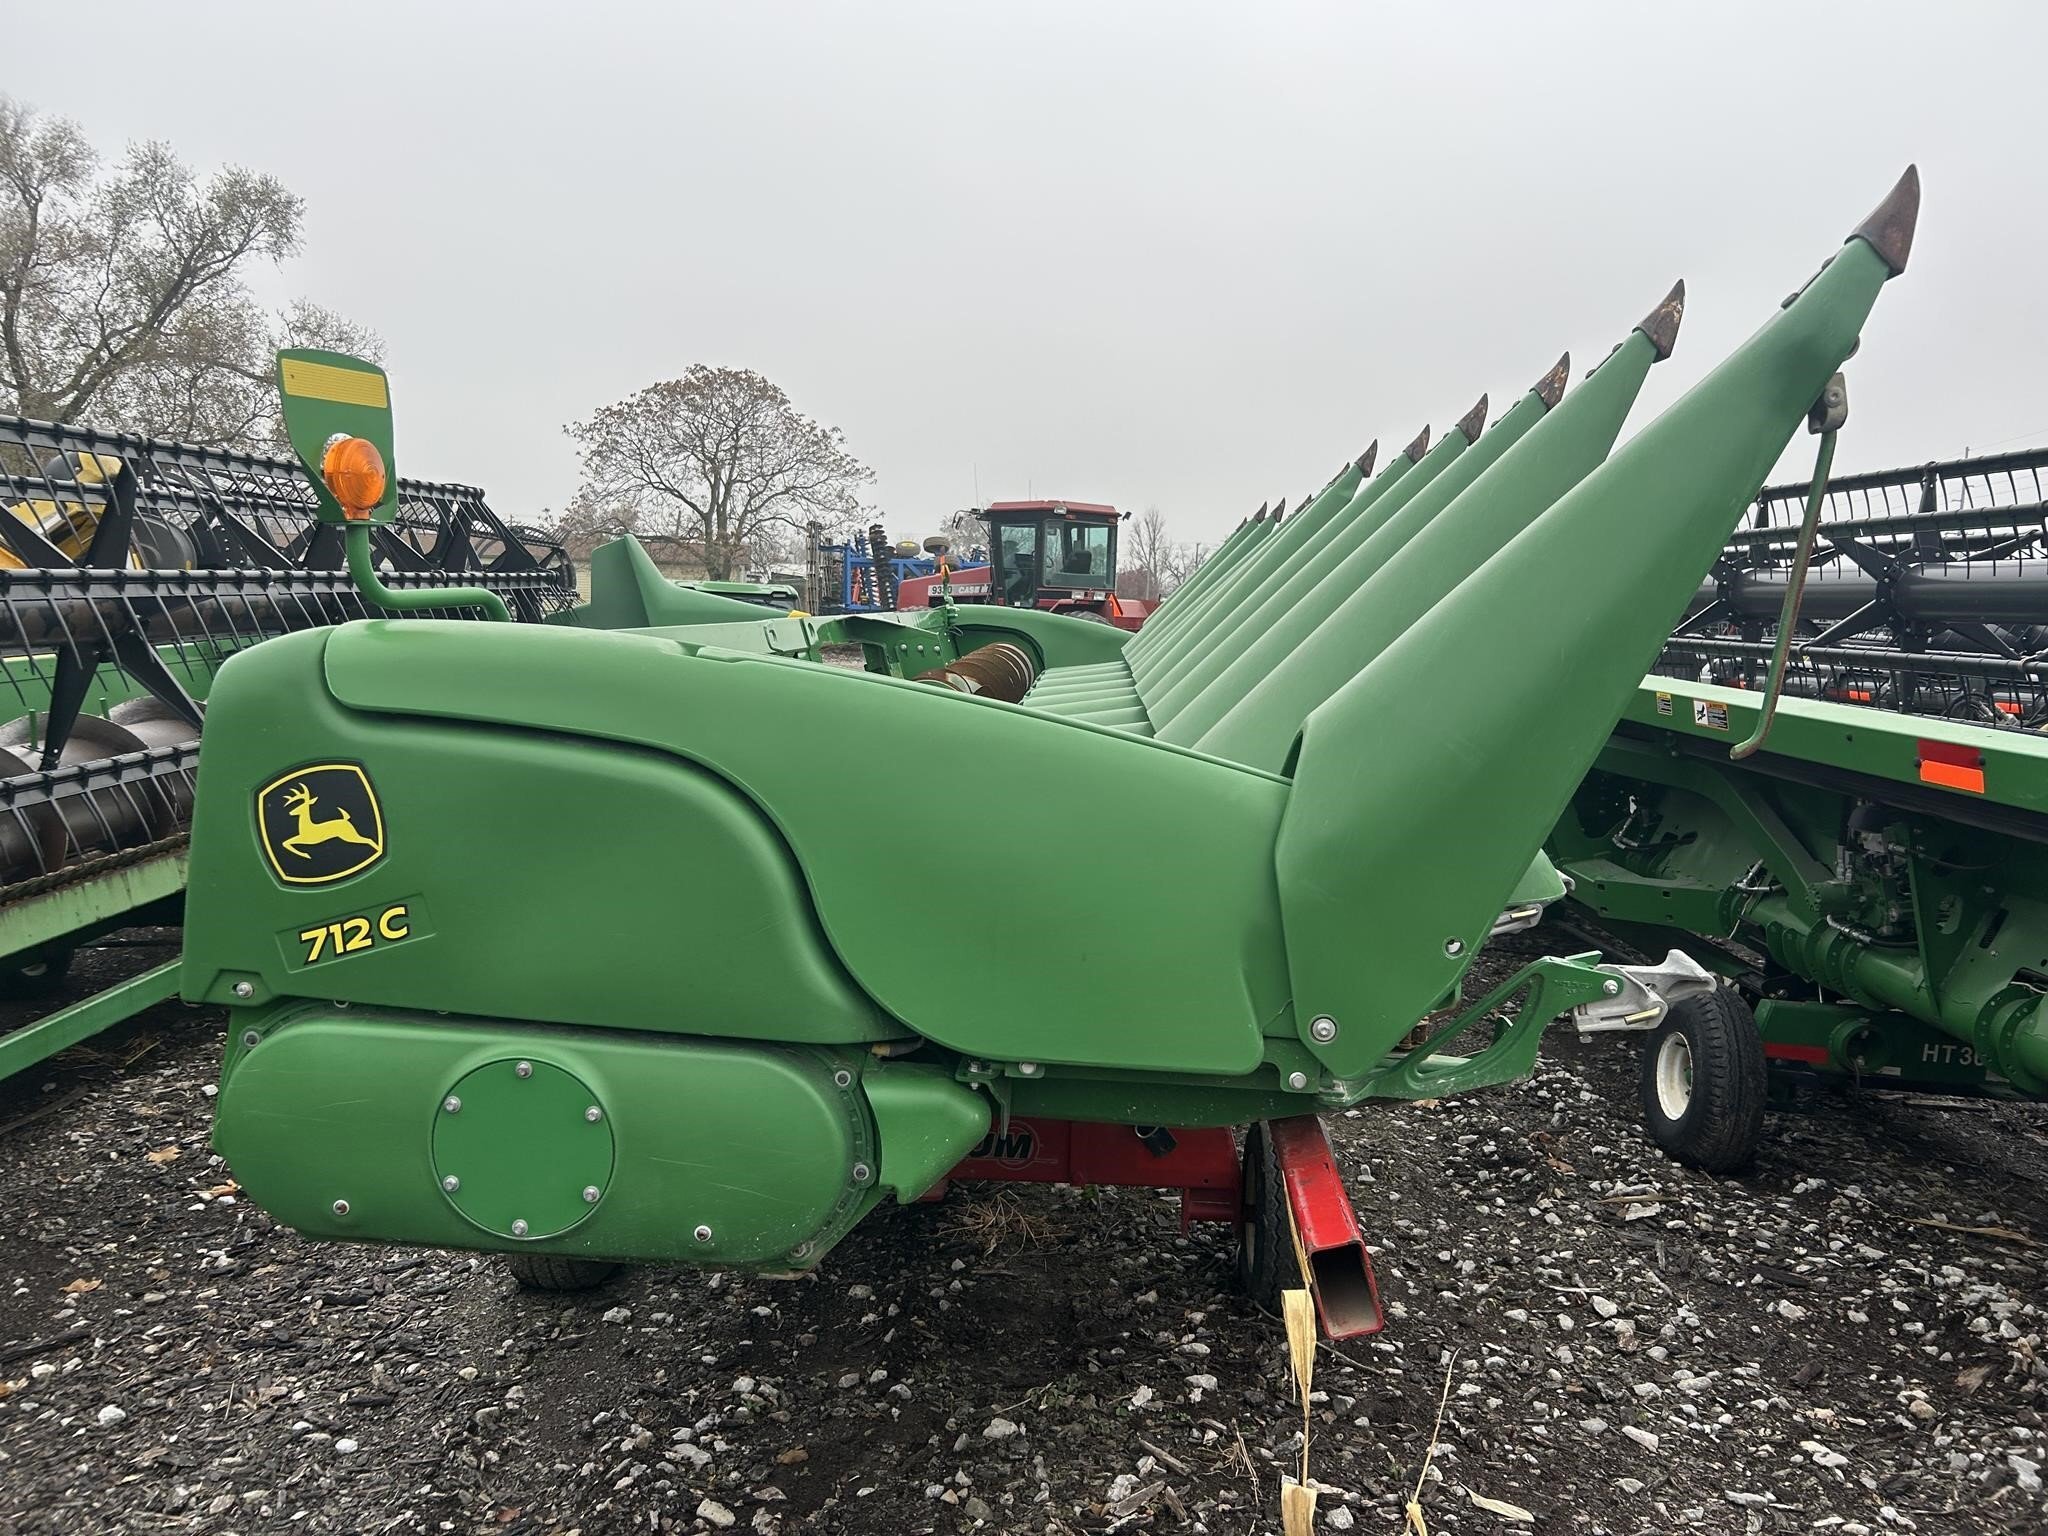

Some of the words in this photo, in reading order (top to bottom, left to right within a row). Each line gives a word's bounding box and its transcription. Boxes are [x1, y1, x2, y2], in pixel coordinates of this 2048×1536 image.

[932, 585, 952, 595] 930
[959, 585, 980, 594] CASE
[300, 916, 373, 963] 712
[378, 905, 408, 940] C
